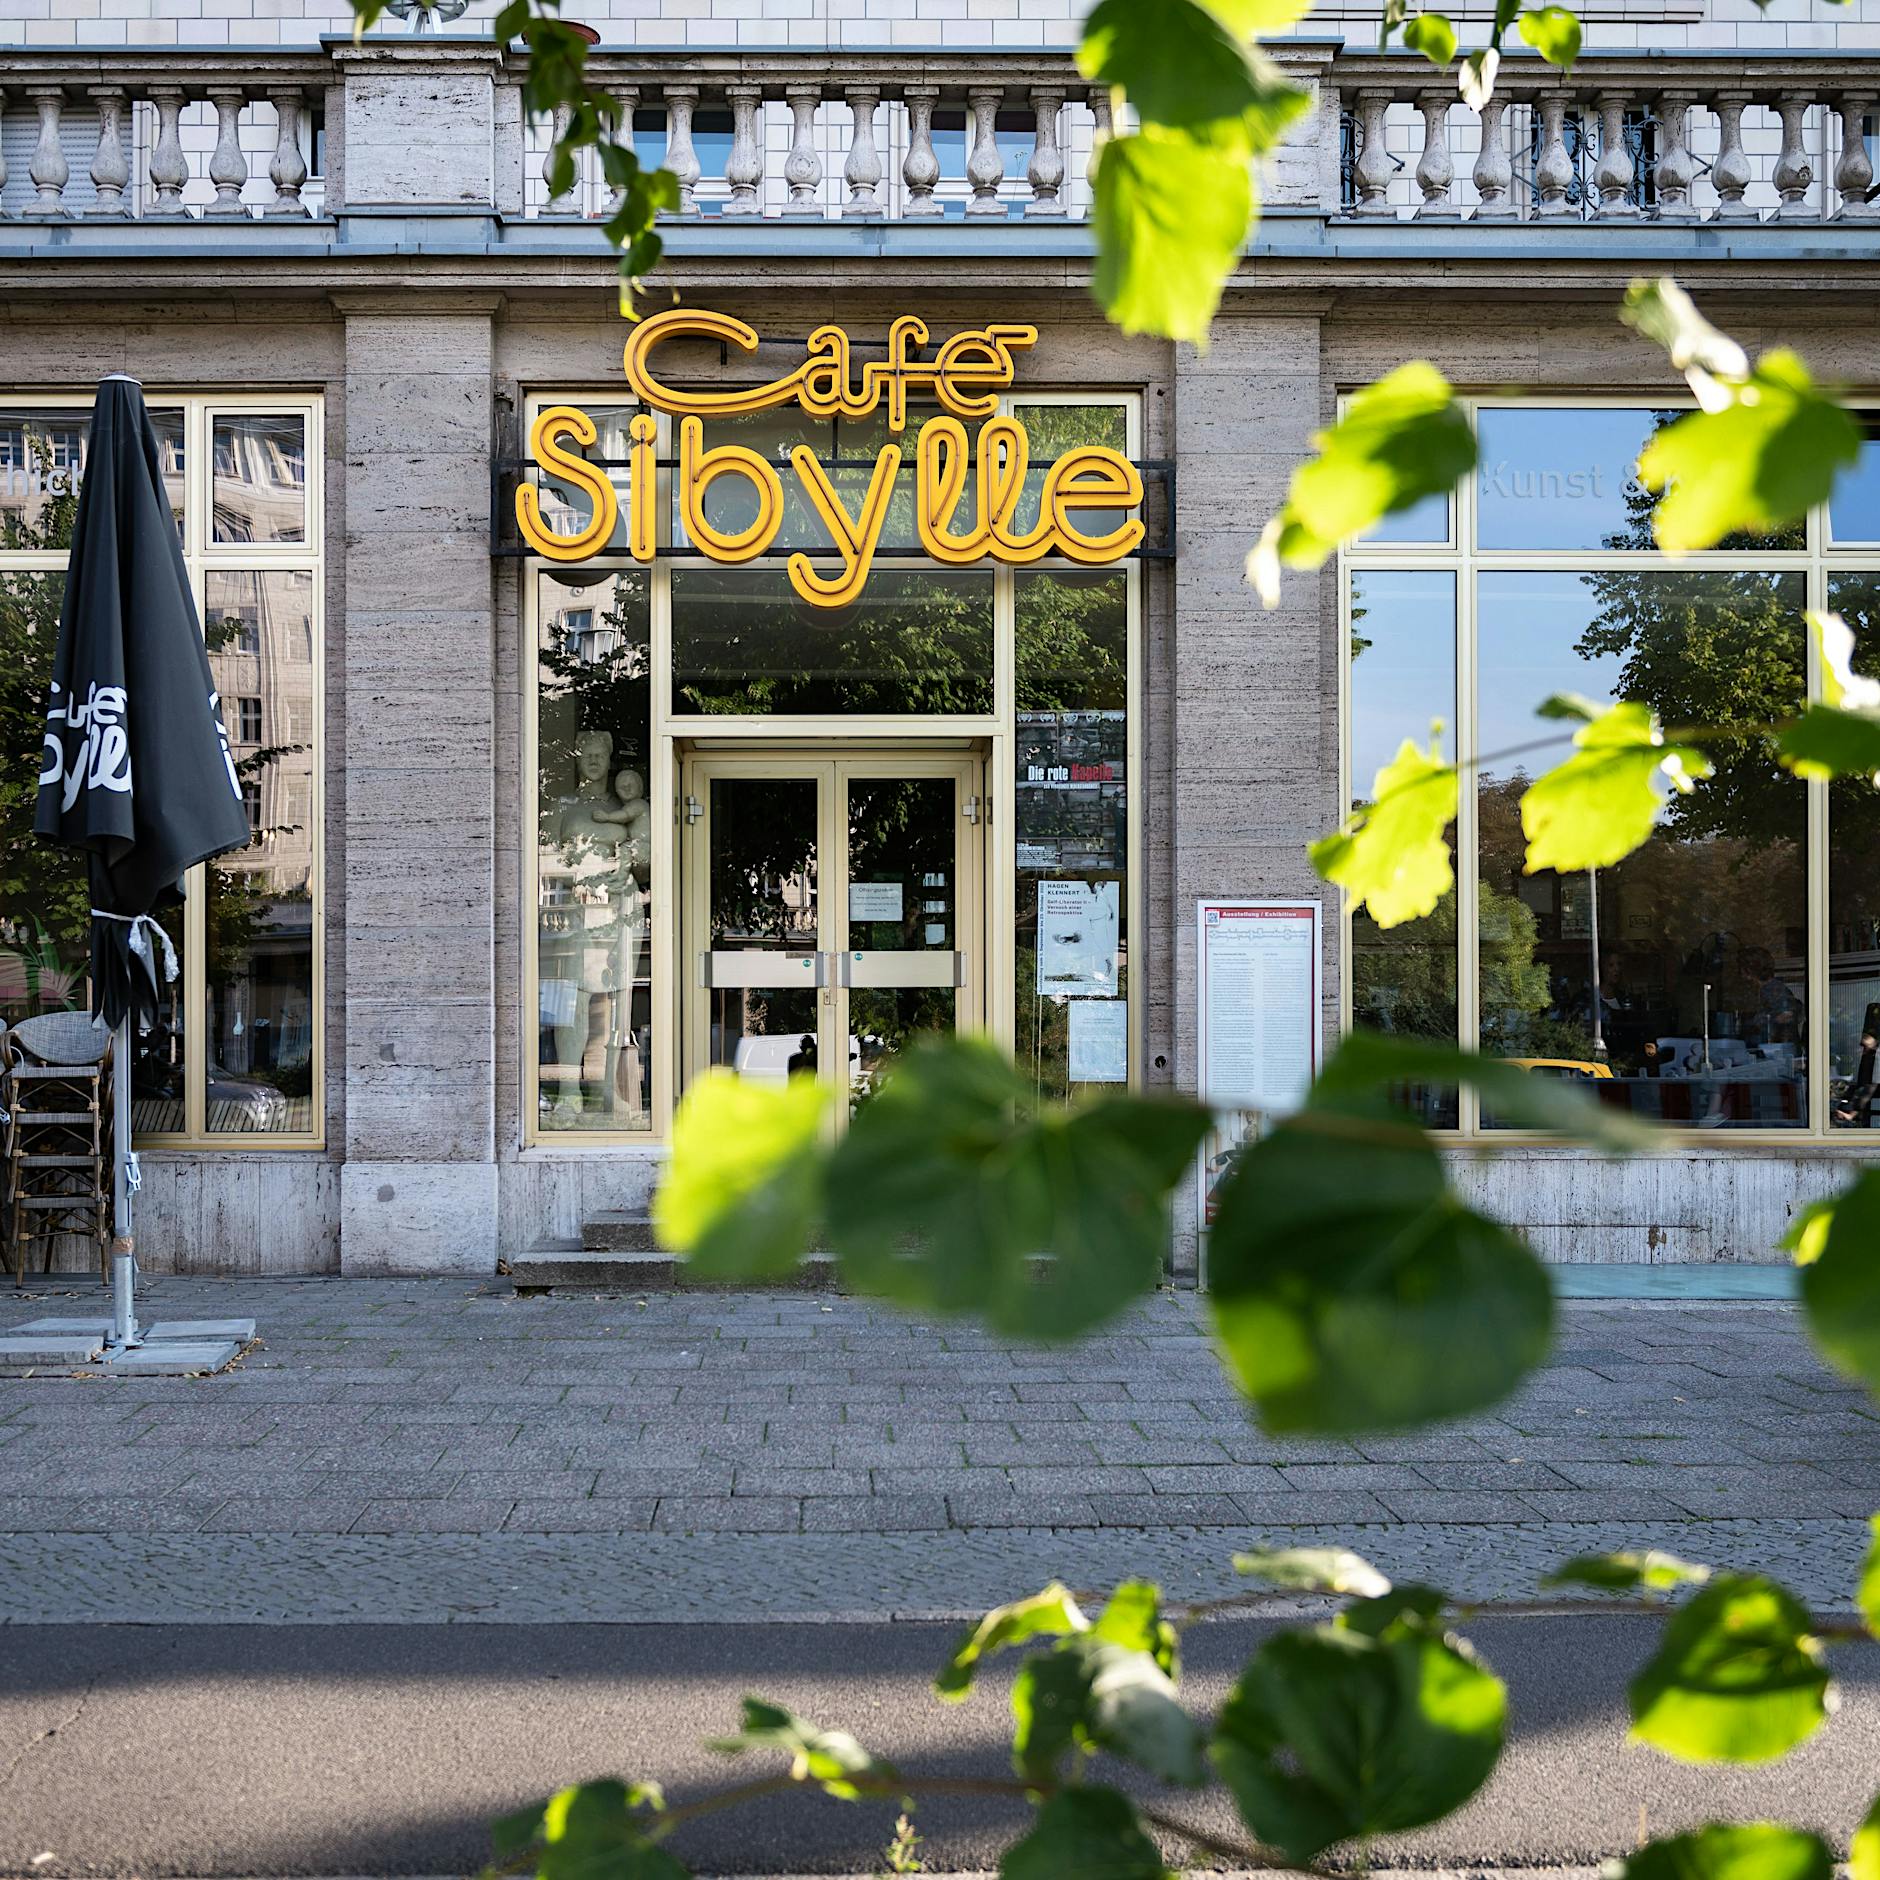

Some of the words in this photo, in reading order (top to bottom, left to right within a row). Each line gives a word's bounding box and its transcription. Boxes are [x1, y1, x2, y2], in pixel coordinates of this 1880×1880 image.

[1482, 460, 1604, 498] Kunst
[1620, 463, 1652, 498] &
[514, 405, 1147, 608] Sibylle
[1028, 764, 1045, 781] Die
[1047, 764, 1069, 781] rote
[1222, 910, 1260, 918] Ausstellung
[1264, 910, 1297, 918] Exhibition
